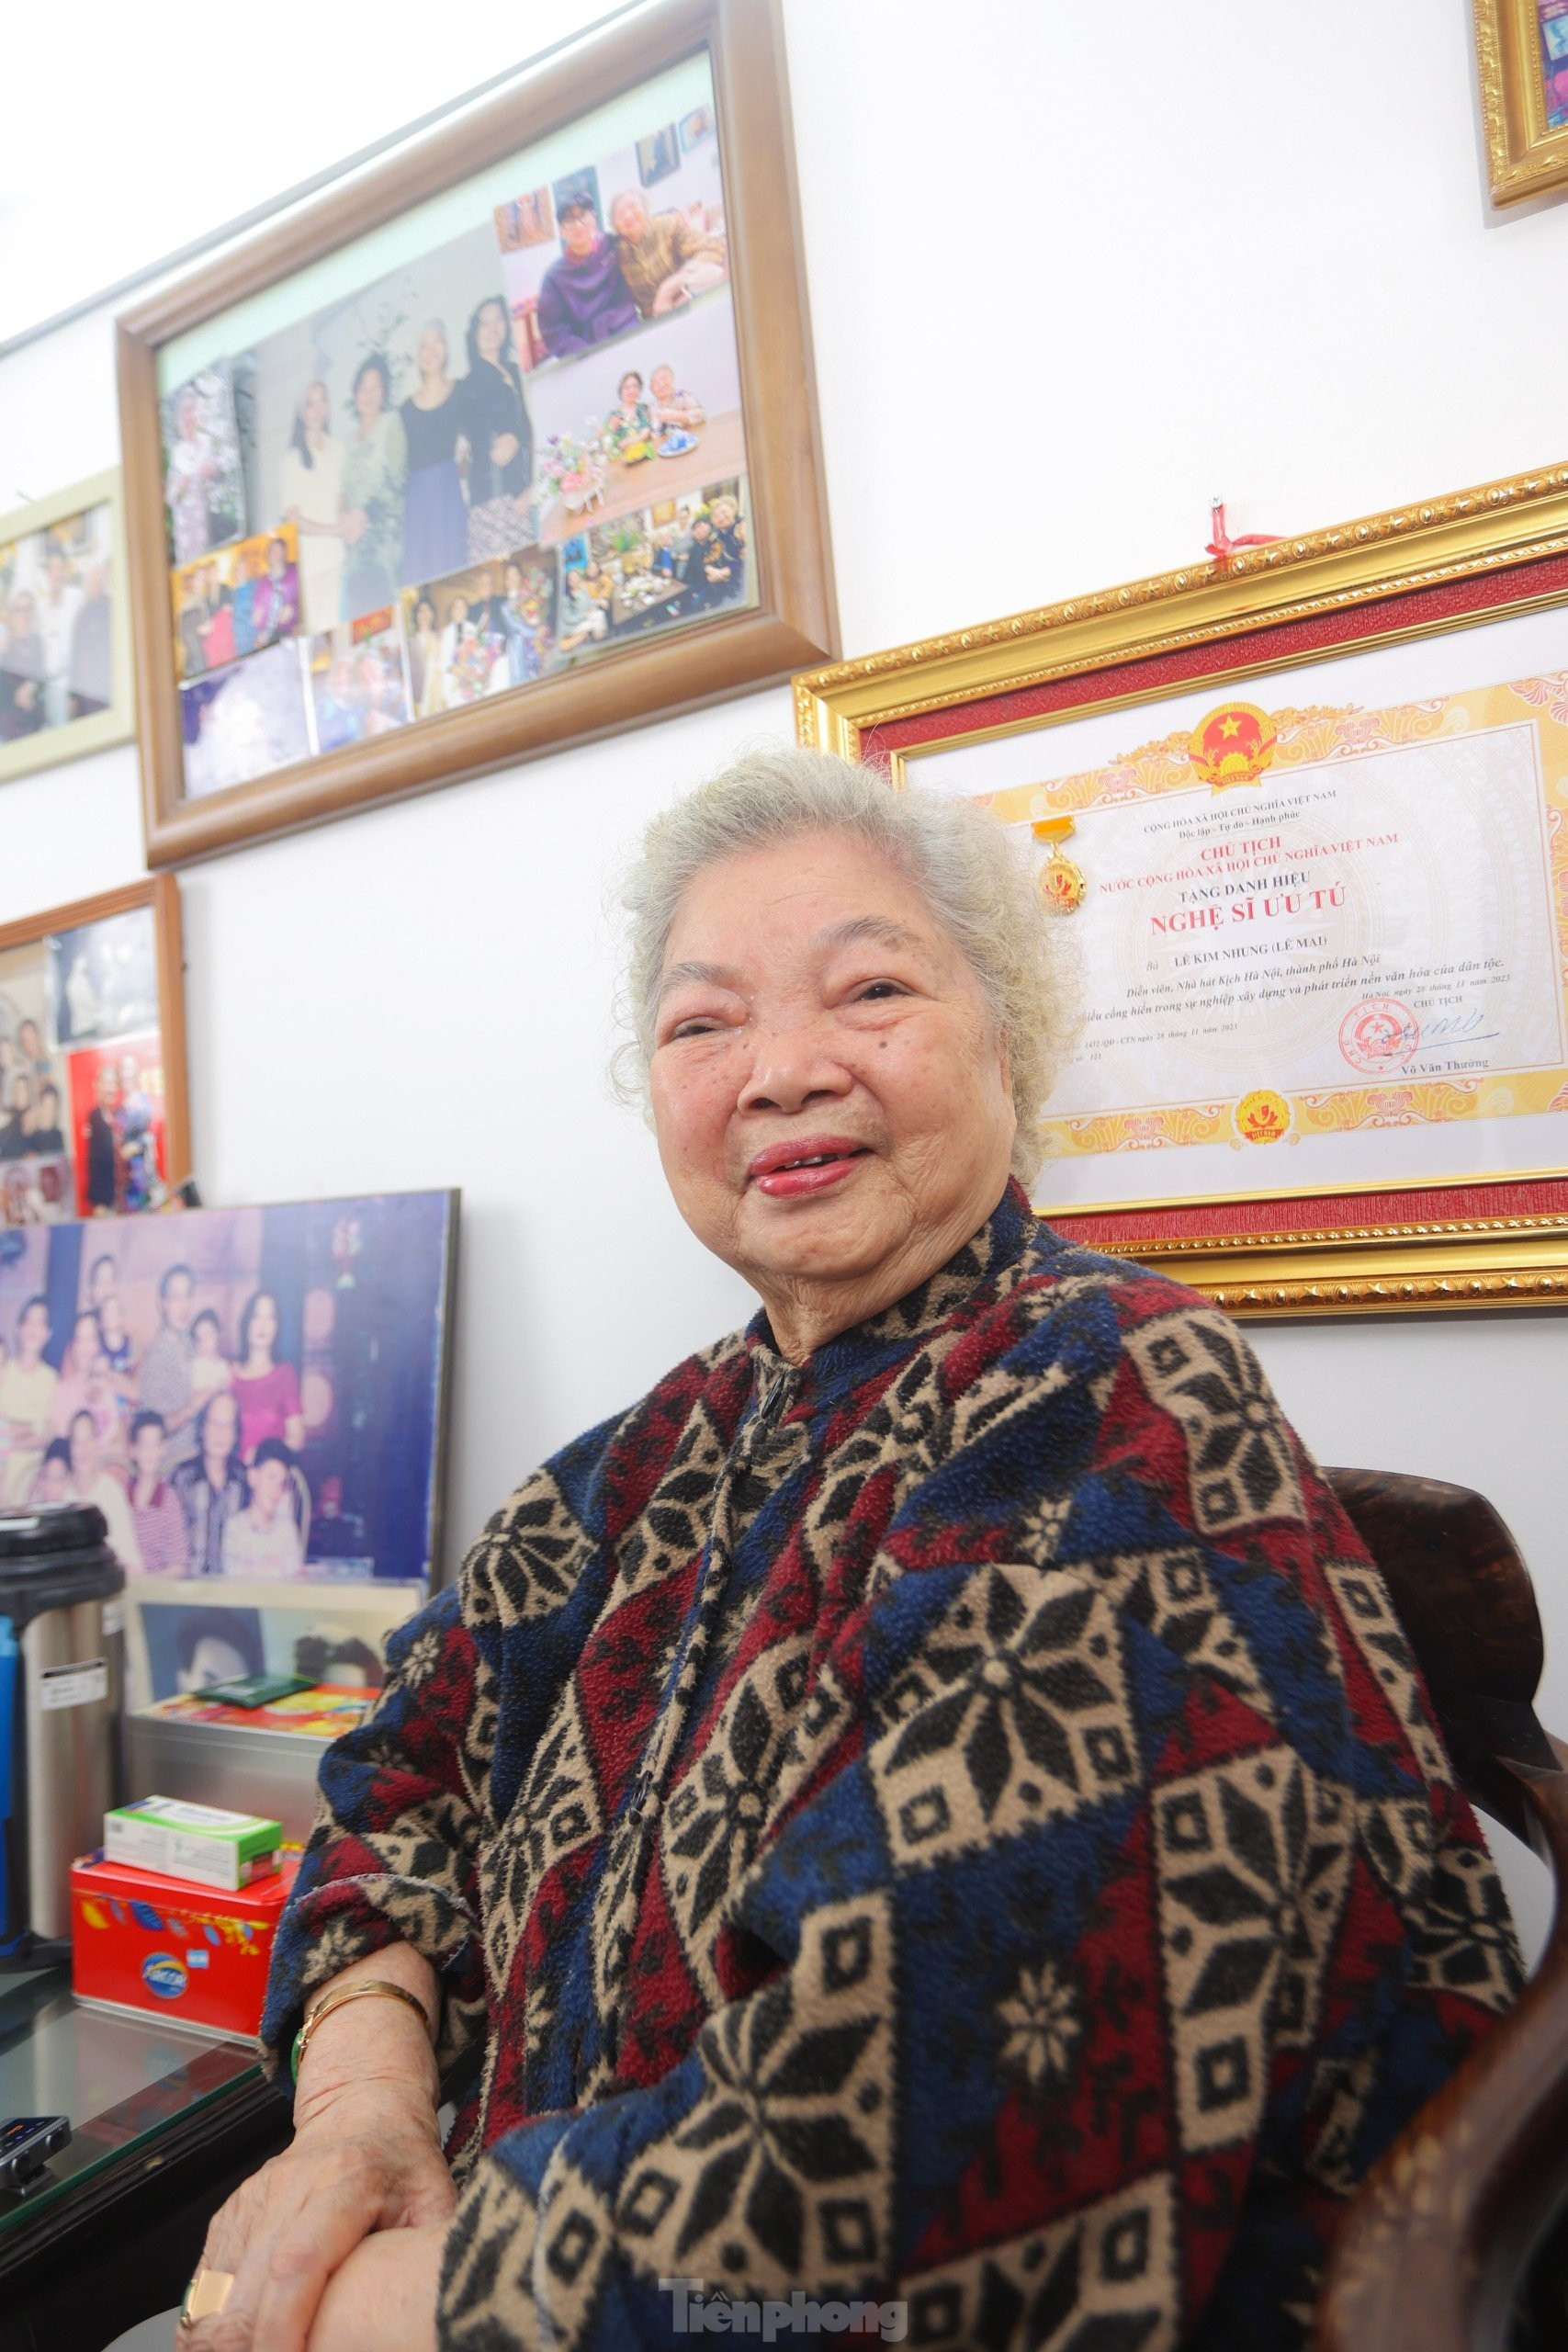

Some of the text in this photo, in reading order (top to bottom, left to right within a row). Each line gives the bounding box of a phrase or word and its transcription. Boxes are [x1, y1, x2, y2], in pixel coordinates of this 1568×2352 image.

[1144, 790, 1337, 834] CỘNG HÒA XÃ HỘI CHỦ NGHĨA VIỆT NAM
[1179, 829, 1195, 840] Độc
[1197, 827, 1211, 839] lập
[1219, 823, 1231, 833] Tự
[1233, 820, 1244, 829] do
[1252, 815, 1276, 827] Hạnh
[1279, 809, 1301, 824] phúc
[1100, 832, 1399, 894] NƯỚC CỘNG HÒA XÃ HỘI CHỦ NGHĨA VIỆT NAM
[1201, 835, 1281, 861] CHỦ TỊCH
[1179, 870, 1312, 904] TẶNG DANH HIỆU
[1150, 880, 1347, 935] NGHỆ SĨ ƯU TÚ
[1146, 935, 1327, 971] Bà LÊ KIM NHUNG (LÊ MAI)
[1105, 1006, 1128, 1022] cống
[1131, 1001, 1152, 1016] hiến
[1155, 1000, 1182, 1014] trong
[1185, 1000, 1198, 1011] sự
[1200, 994, 1235, 1010] nghiệp
[1237, 991, 1256, 1004] xây
[1259, 987, 1286, 1001] dựng
[1290, 985, 1303, 995] và
[1304, 979, 1330, 994] phát
[1332, 975, 1358, 989] triển
[1360, 971, 1382, 986] nền
[1385, 969, 1405, 982] văn
[1408, 966, 1432, 979] hóa
[1434, 963, 1455, 976] của
[1459, 959, 1481, 972] dân
[1483, 957, 1505, 971] tộc.
[1126, 953, 1382, 998] Diễn viên, Nhà hát Kịch Hà Nội, thành phố Hà Nội
[1362, 990, 1374, 1001] Hà
[1394, 988, 1413, 998] ngày
[1416, 985, 1426, 993] 28
[1429, 982, 1452, 993] tháng
[1456, 980, 1465, 989] 11
[1470, 978, 1487, 987] năm
[1492, 974, 1511, 985] 2023
[1414, 995, 1463, 1009] CHỦ TỊCH
[1121, 1035, 1136, 1046] CTN
[1221, 1023, 1238, 1033] 2023
[1402, 1057, 1490, 1075] Võ Văn Thưởng
